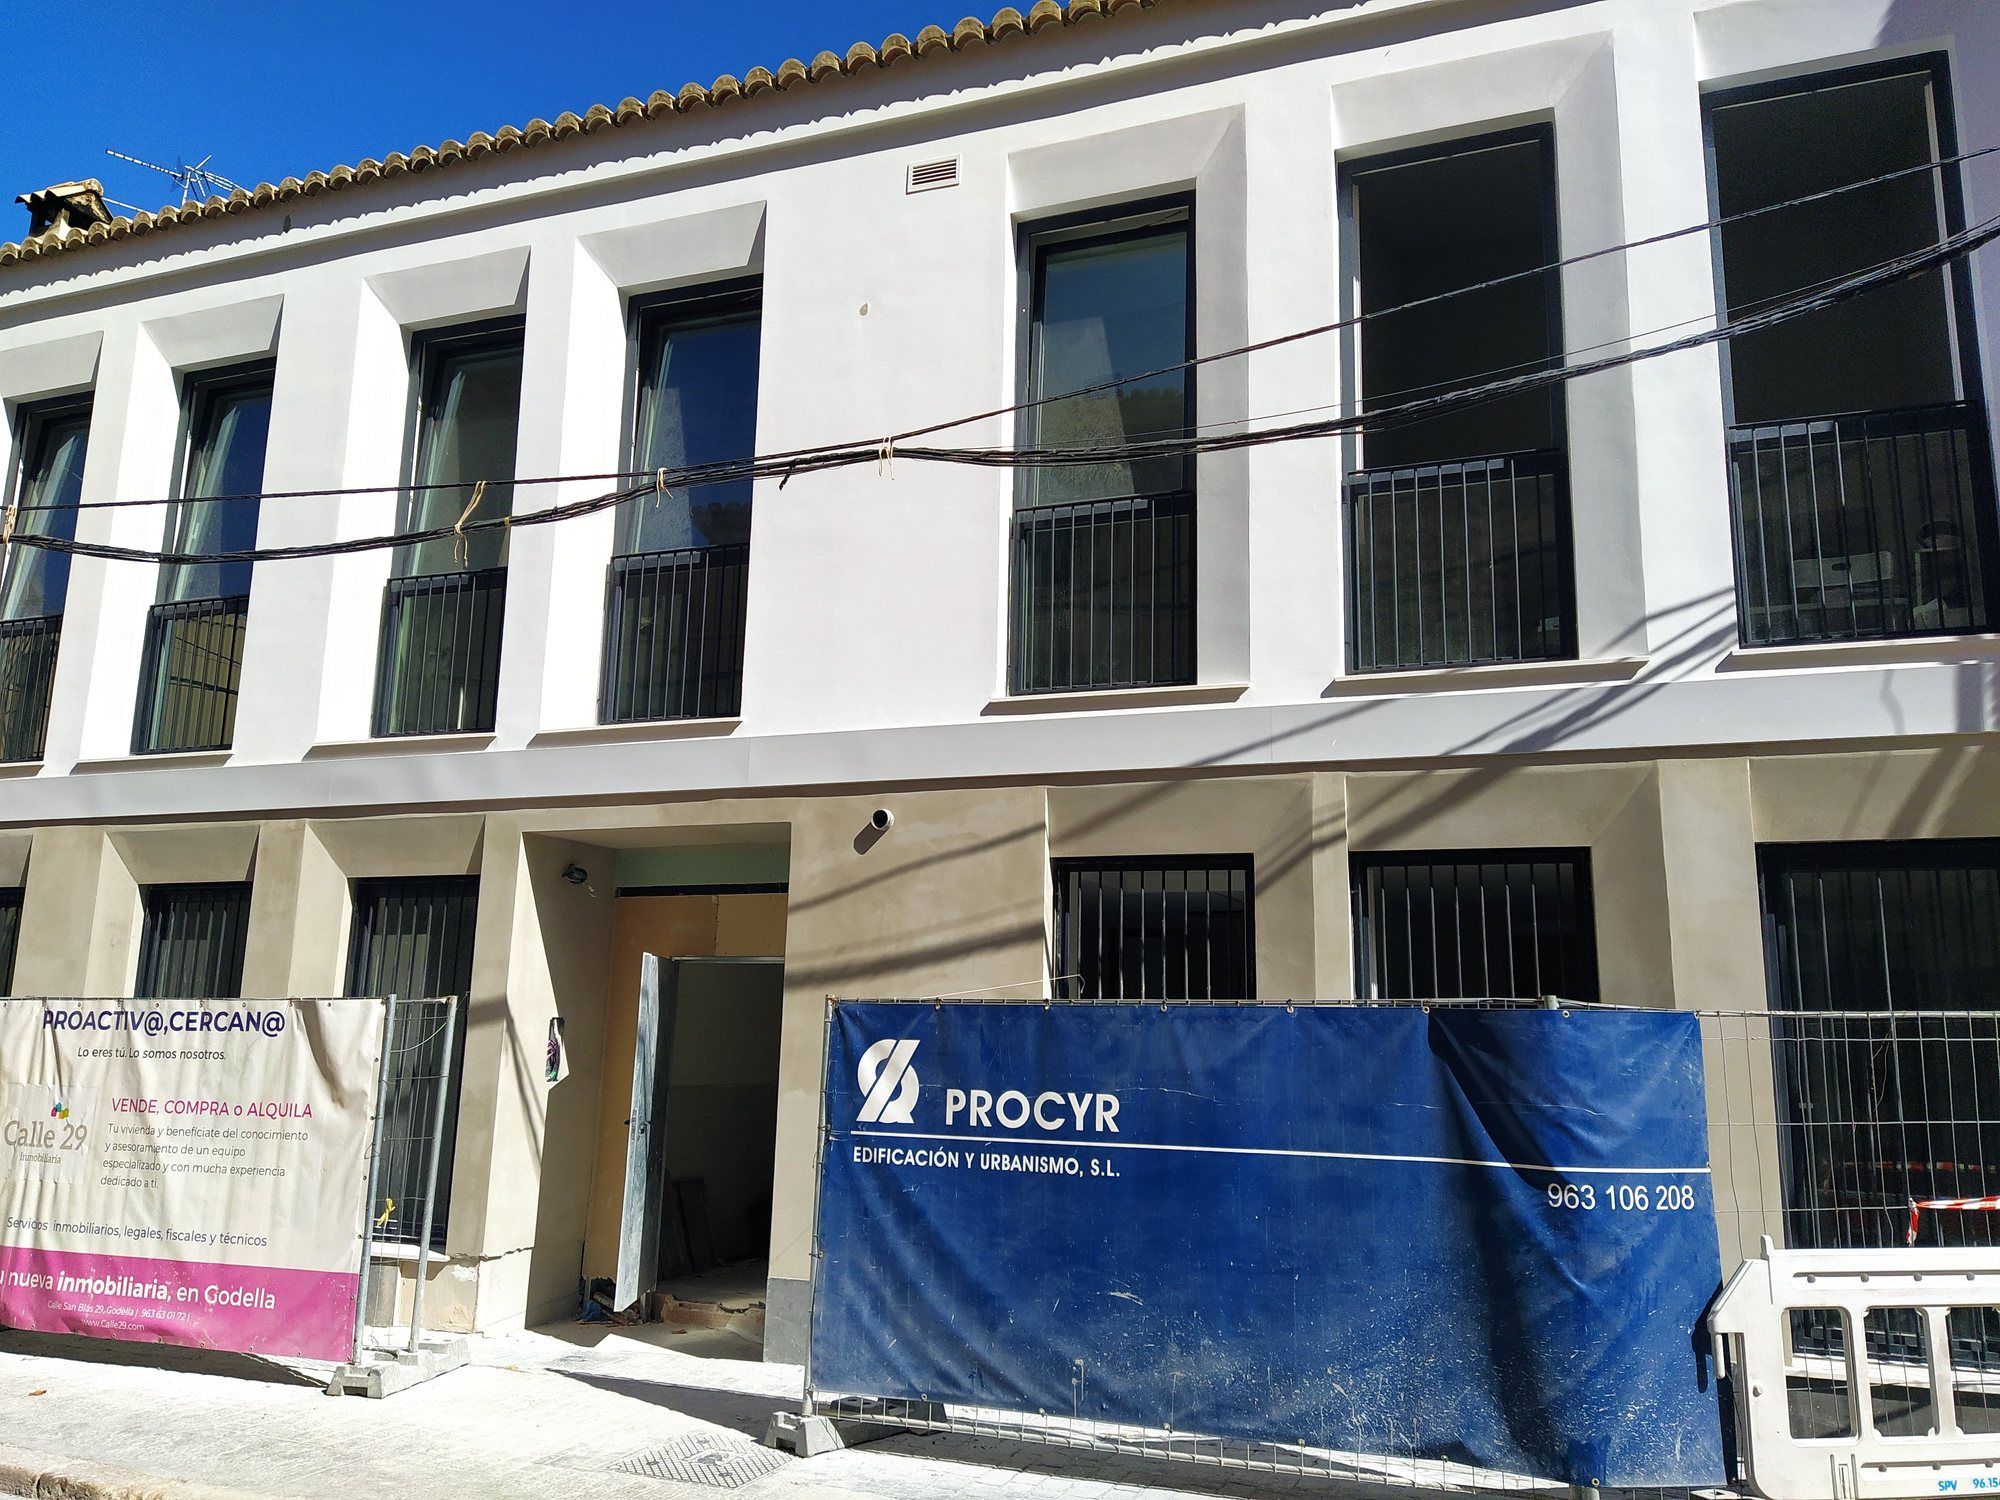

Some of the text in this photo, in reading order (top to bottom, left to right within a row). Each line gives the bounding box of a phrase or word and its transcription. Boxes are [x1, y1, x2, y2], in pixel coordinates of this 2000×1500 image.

[77, 1046, 89, 1058] Lo
[91, 1048, 113, 1058] eres
[128, 1047, 140, 1059] Lo
[142, 1049, 177, 1060] somos
[179, 1049, 226, 1060] nosotros.
[111, 1098, 313, 1120] VENDE, COMPRA o ALQUILA
[945, 1088, 1121, 1134] PROCYR
[3, 1120, 88, 1151] Calle 29
[108, 1123, 119, 1134] Tu
[120, 1124, 156, 1136] vivienda
[157, 1127, 164, 1138] y
[222, 1127, 238, 1139] del
[240, 1129, 309, 1141] conocimiento
[19, 1152, 62, 1164] Inmobiliaria
[104, 1142, 246, 1158] y asesoramiento de un equipo
[102, 1158, 286, 1178] especializado y con mucha experiencia
[853, 1145, 1121, 1179] EDIFICACIÓN Y URBANISMO, S.L.
[100, 1175, 143, 1188] dedicado
[143, 1180, 149, 1188] a
[1547, 1183, 1695, 1211] 963 106 208
[52, 1219, 122, 1238] inmobiliarios,
[123, 1224, 164, 1242] legales,
[165, 1226, 207, 1243] fiscales
[208, 1233, 217, 1246] y
[219, 1232, 268, 1247] técnicos
[8, 1270, 54, 1290] nueva
[56, 1270, 172, 1303] inmobiliaria,
[176, 1286, 199, 1303] en
[204, 1284, 276, 1309] Godella
[62, 1301, 77, 1312] San
[1938, 1479, 1958, 1492] SPV
